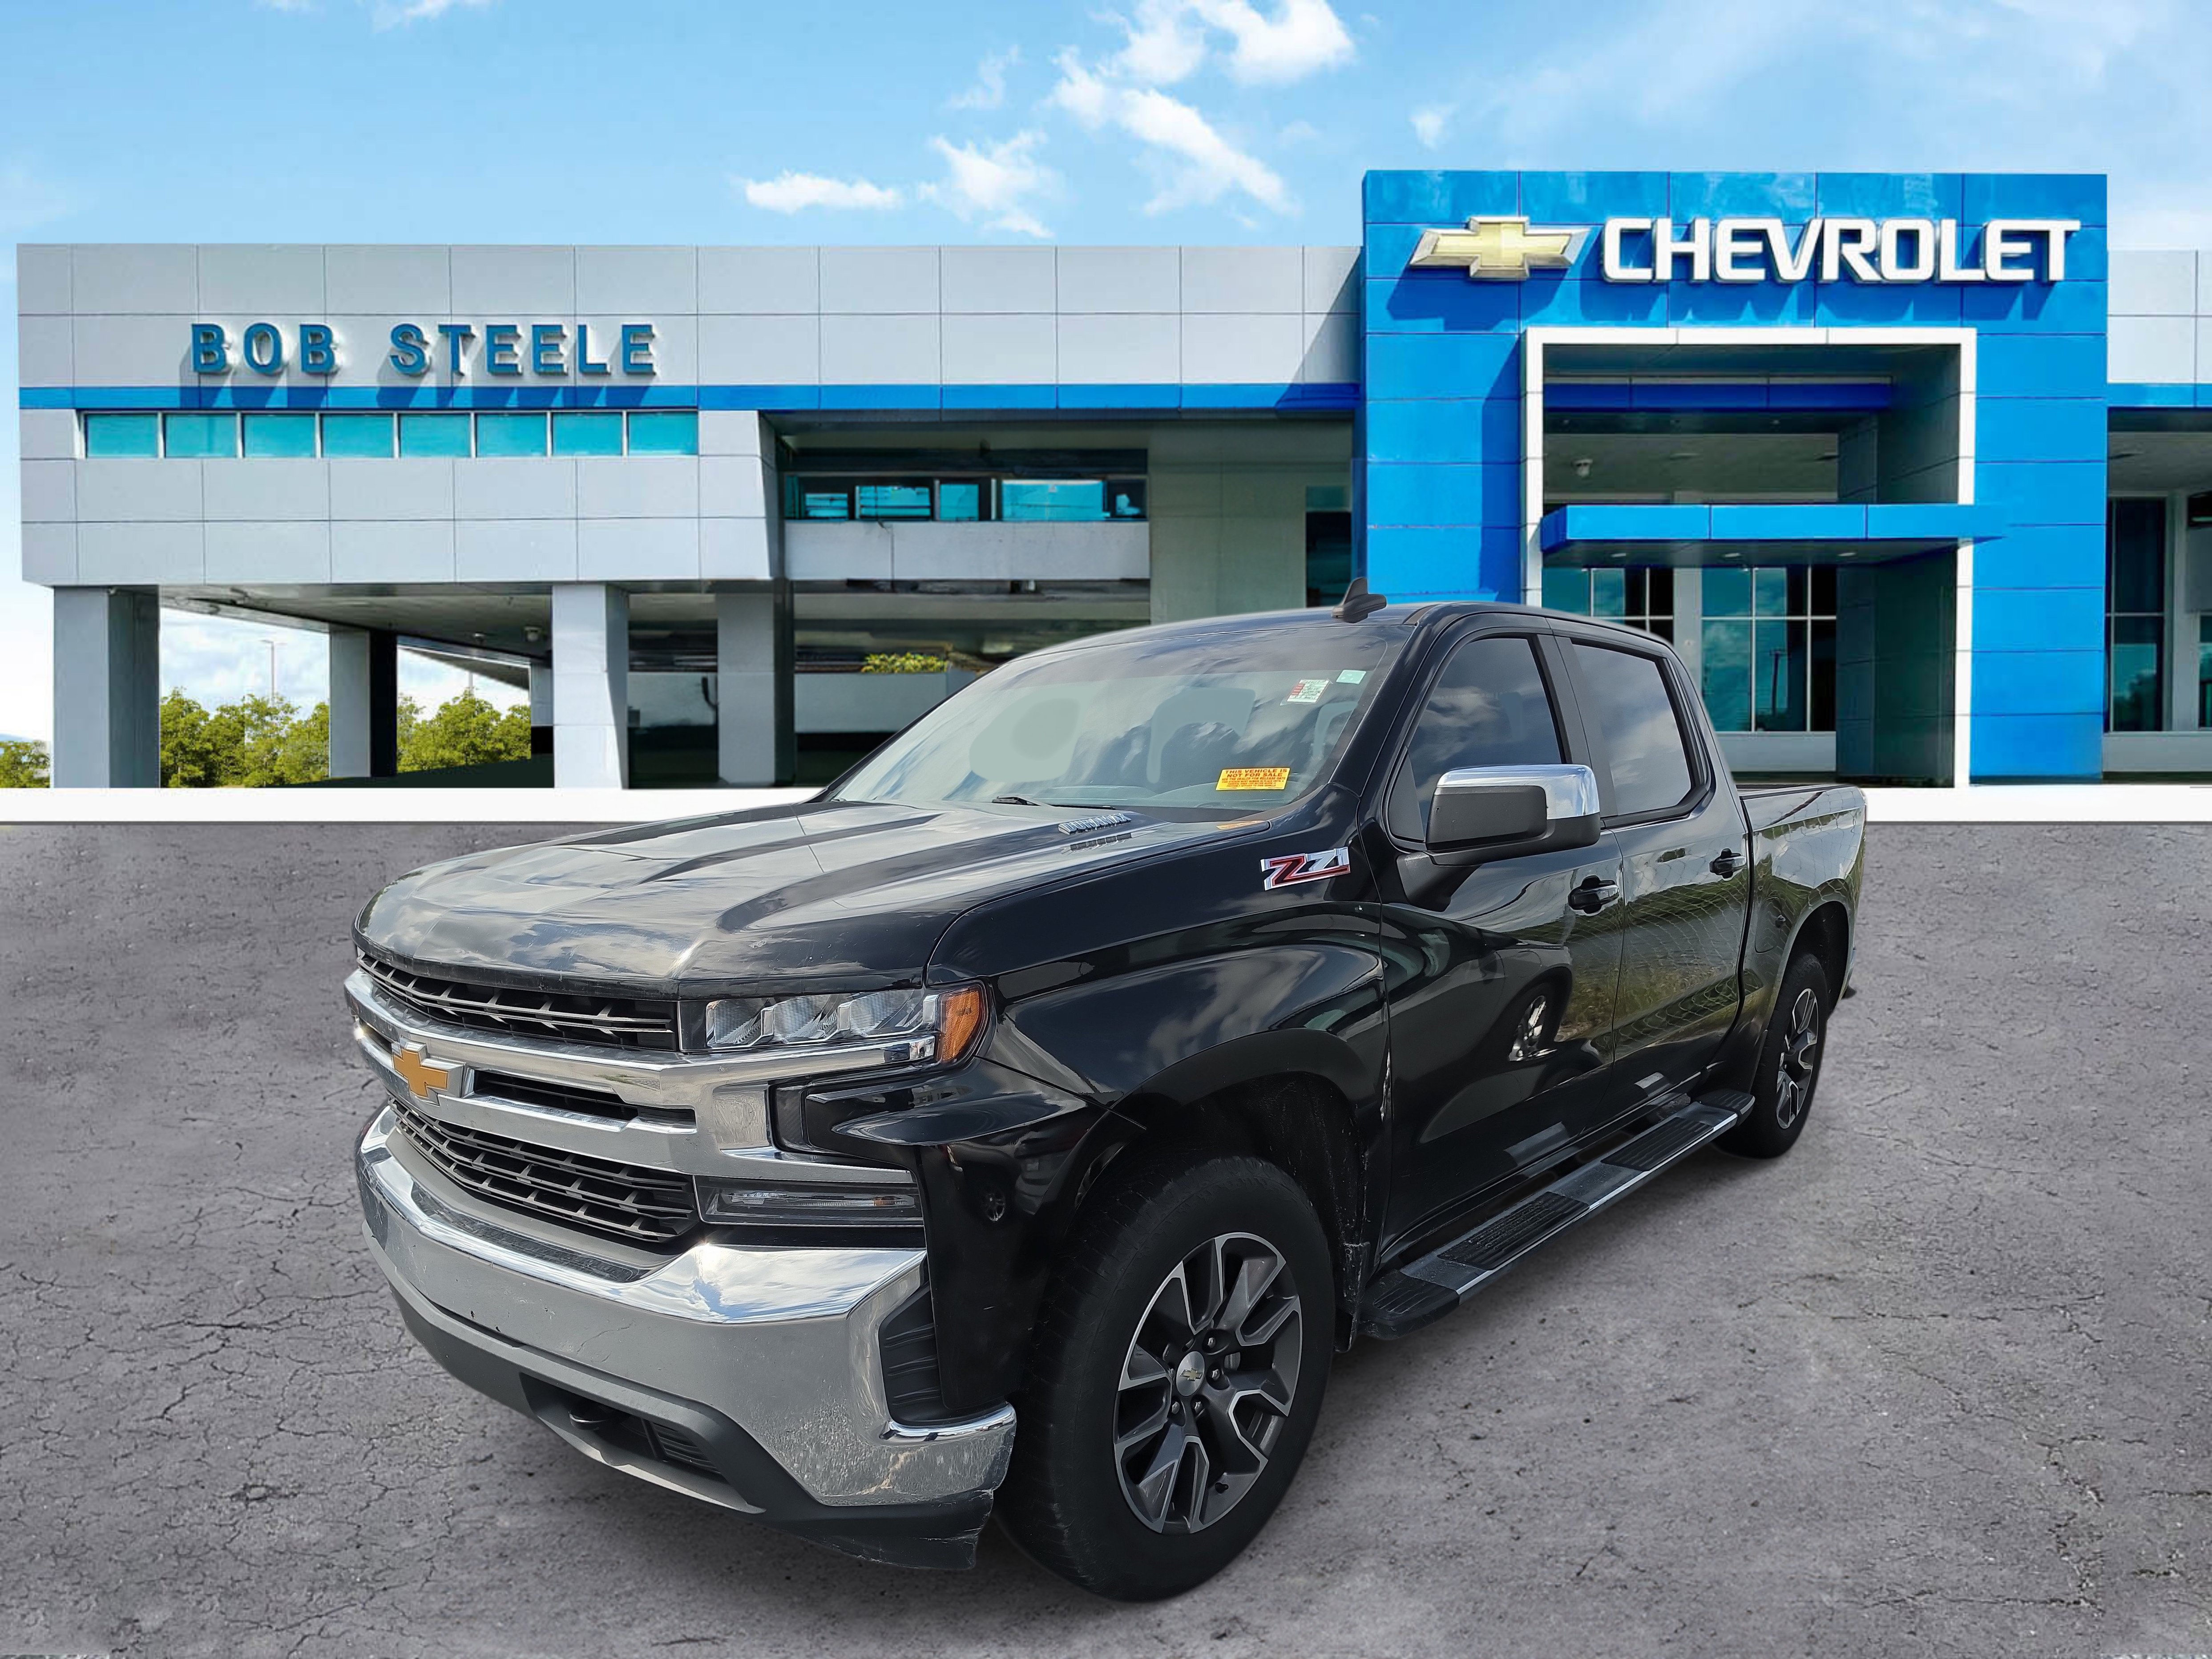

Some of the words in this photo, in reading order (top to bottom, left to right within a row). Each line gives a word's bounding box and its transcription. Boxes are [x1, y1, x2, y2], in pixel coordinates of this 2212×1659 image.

[1602, 217, 2081, 283] CHEVROLET
[191, 323, 339, 375] BOB
[390, 323, 656, 376] STEELE
[1058, 813, 1132, 835] DURAMAX
[1260, 846, 1351, 891] Z71
